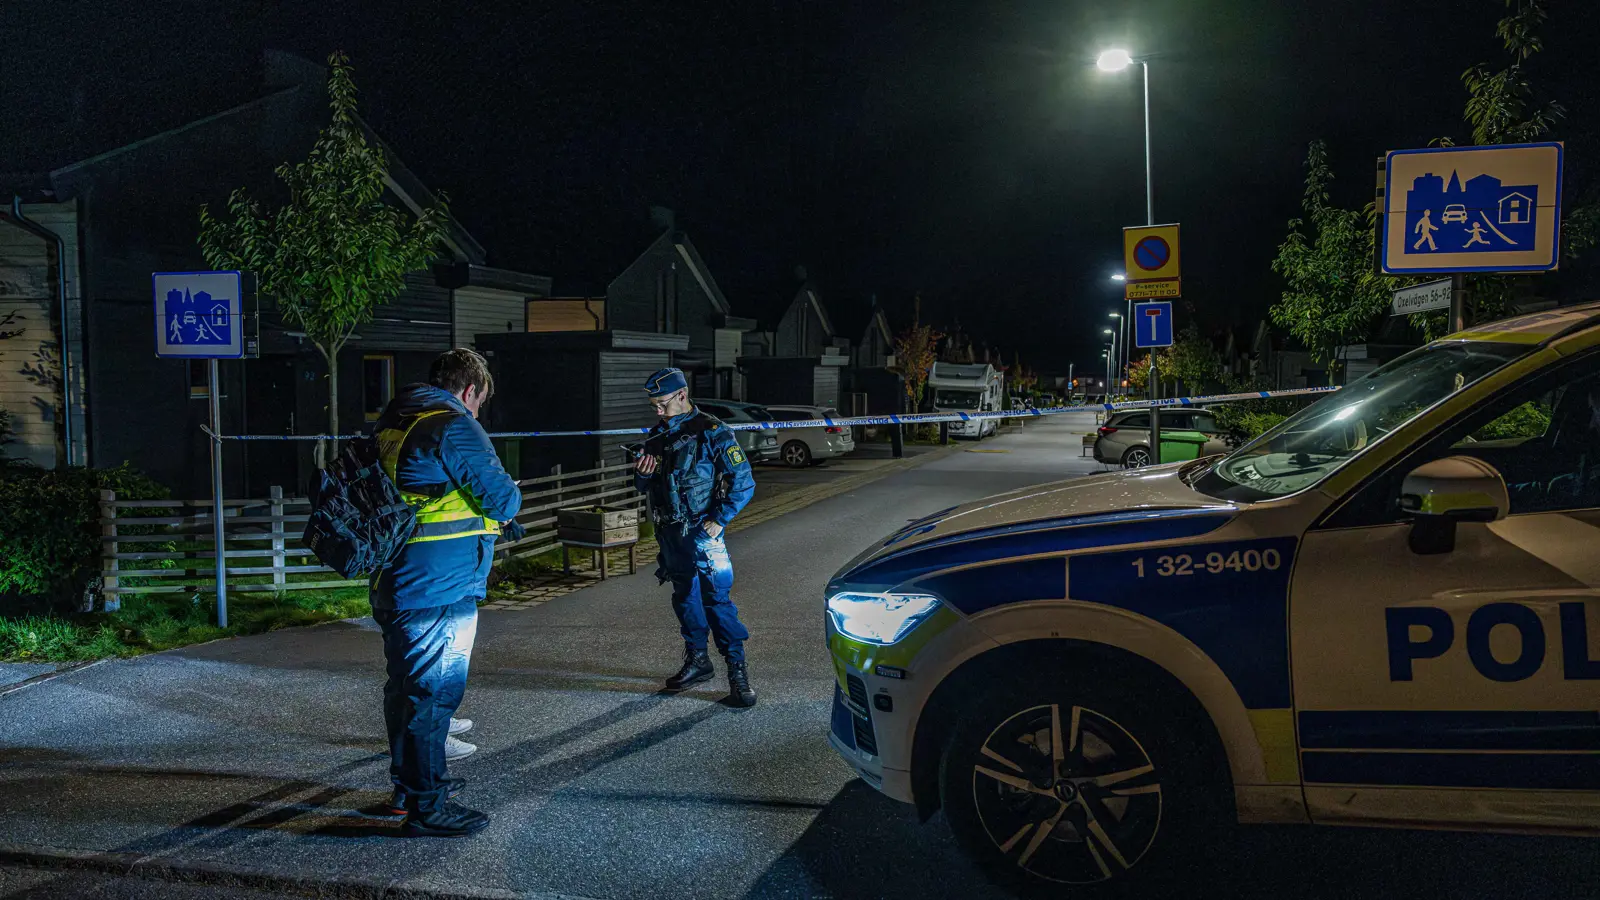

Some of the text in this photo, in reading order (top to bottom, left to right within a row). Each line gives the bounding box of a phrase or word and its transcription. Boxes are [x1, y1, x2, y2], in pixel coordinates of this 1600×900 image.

[1397, 286, 1451, 308] Oxelvägen 56-92
[772, 421, 793, 429] POLIS
[1132, 549, 1281, 578] 1 32-9400
[1385, 602, 1600, 682] POL
